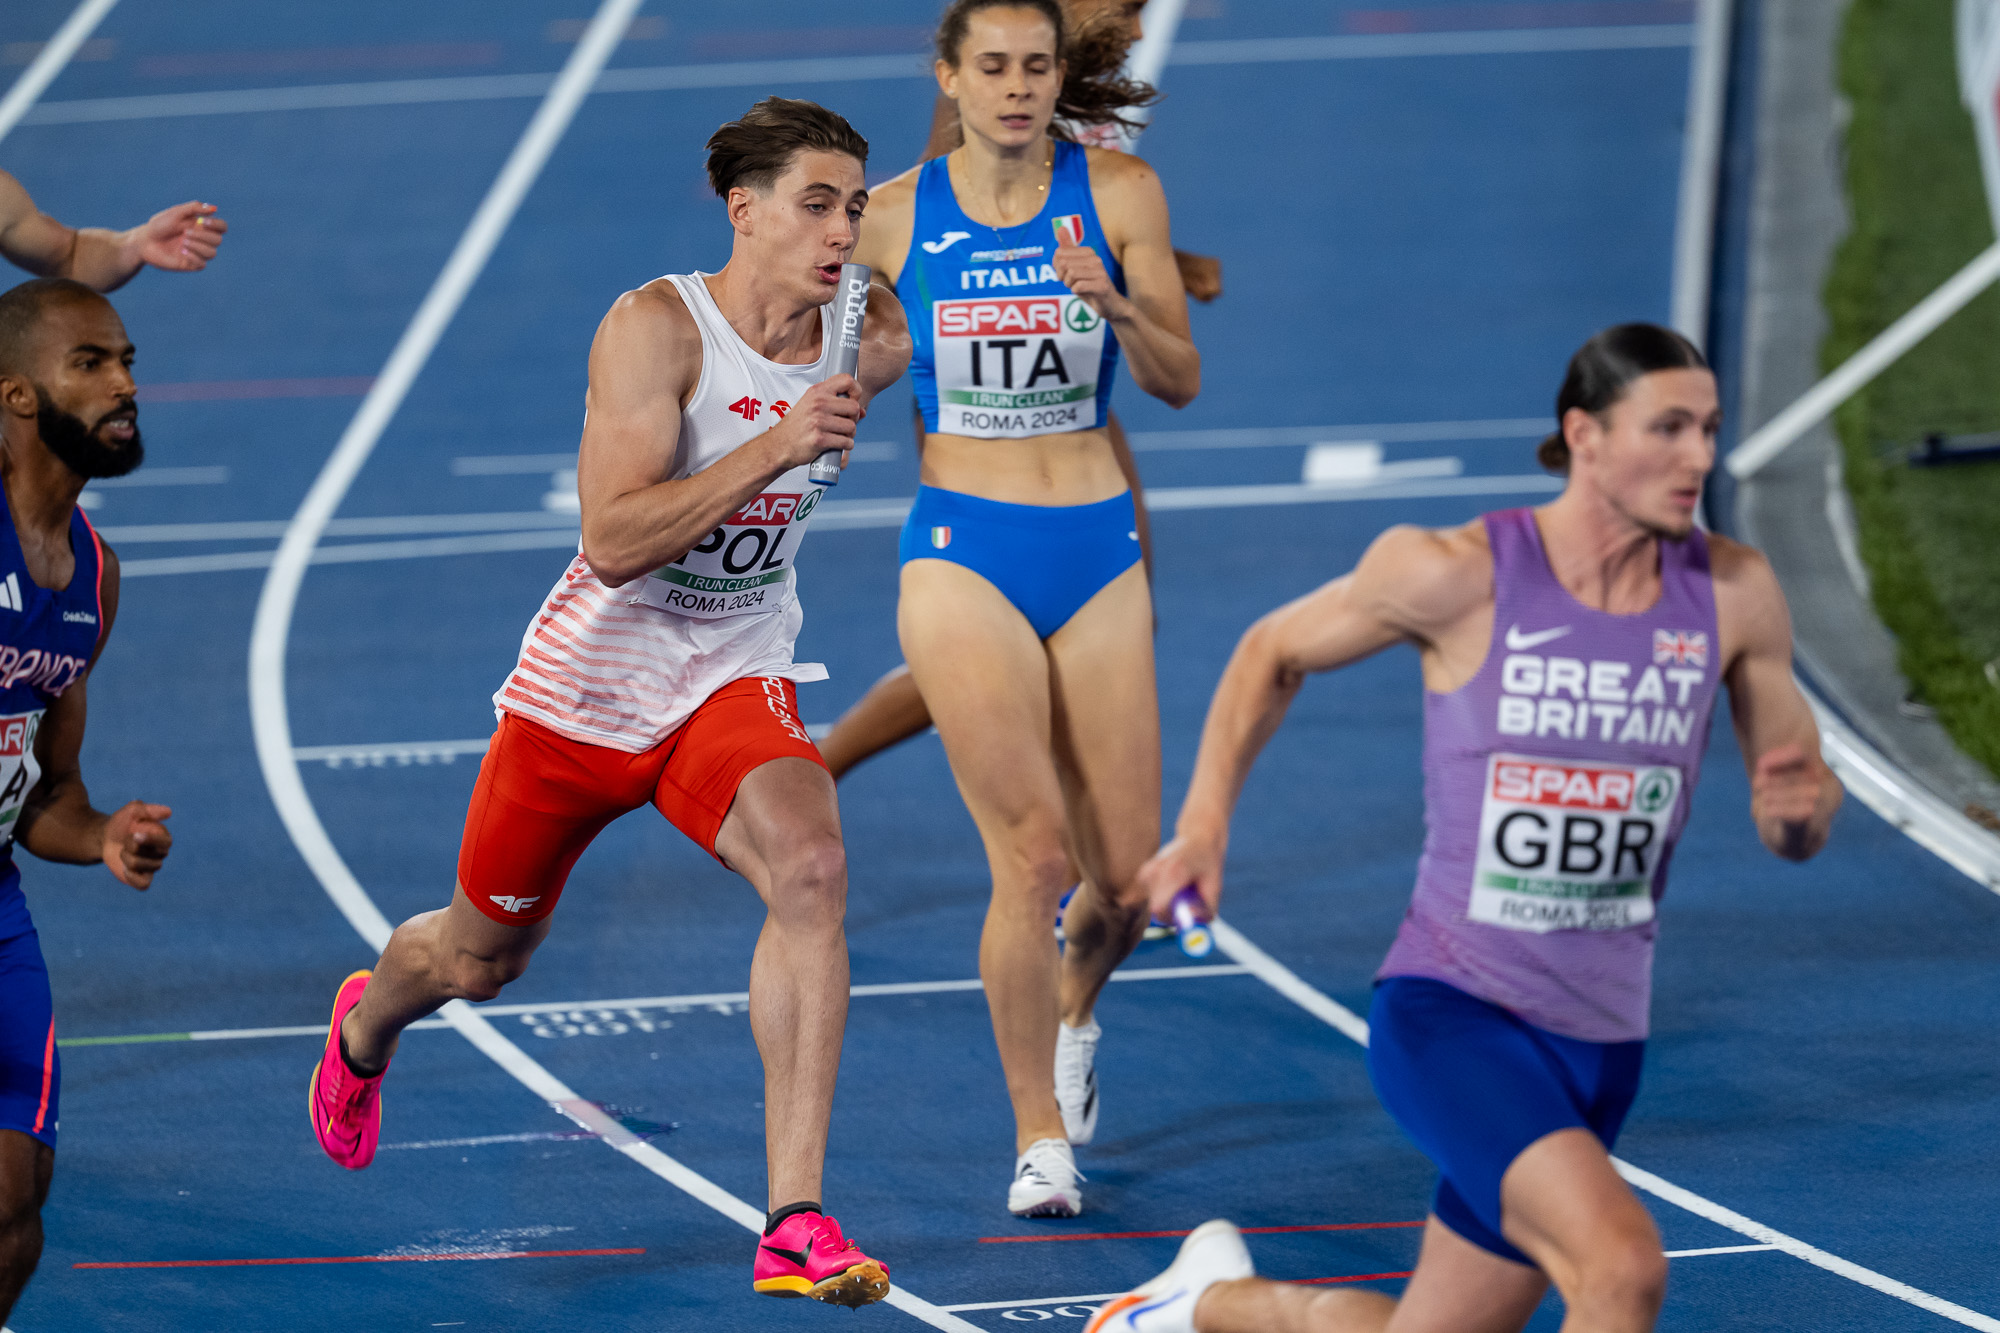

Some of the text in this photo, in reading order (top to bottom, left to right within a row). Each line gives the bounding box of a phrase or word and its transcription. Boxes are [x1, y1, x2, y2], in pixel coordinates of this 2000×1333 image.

[961, 264, 1058, 290] ITALIA
[941, 303, 1058, 333] SPAR
[971, 338, 1070, 389] ITA
[728, 396, 762, 421] 4F
[980, 393, 1013, 408] RUN
[961, 406, 1077, 430] ROMA 2024
[686, 575, 693, 586] I
[694, 578, 725, 590] RUN
[665, 589, 766, 613] ROMA 2024
[0, 644, 86, 697] RANCE
[1502, 654, 1704, 708] GREAT
[1497, 694, 1695, 746] BRITAIN
[1497, 764, 1631, 808] SPAR
[1495, 810, 1655, 876] GBR
